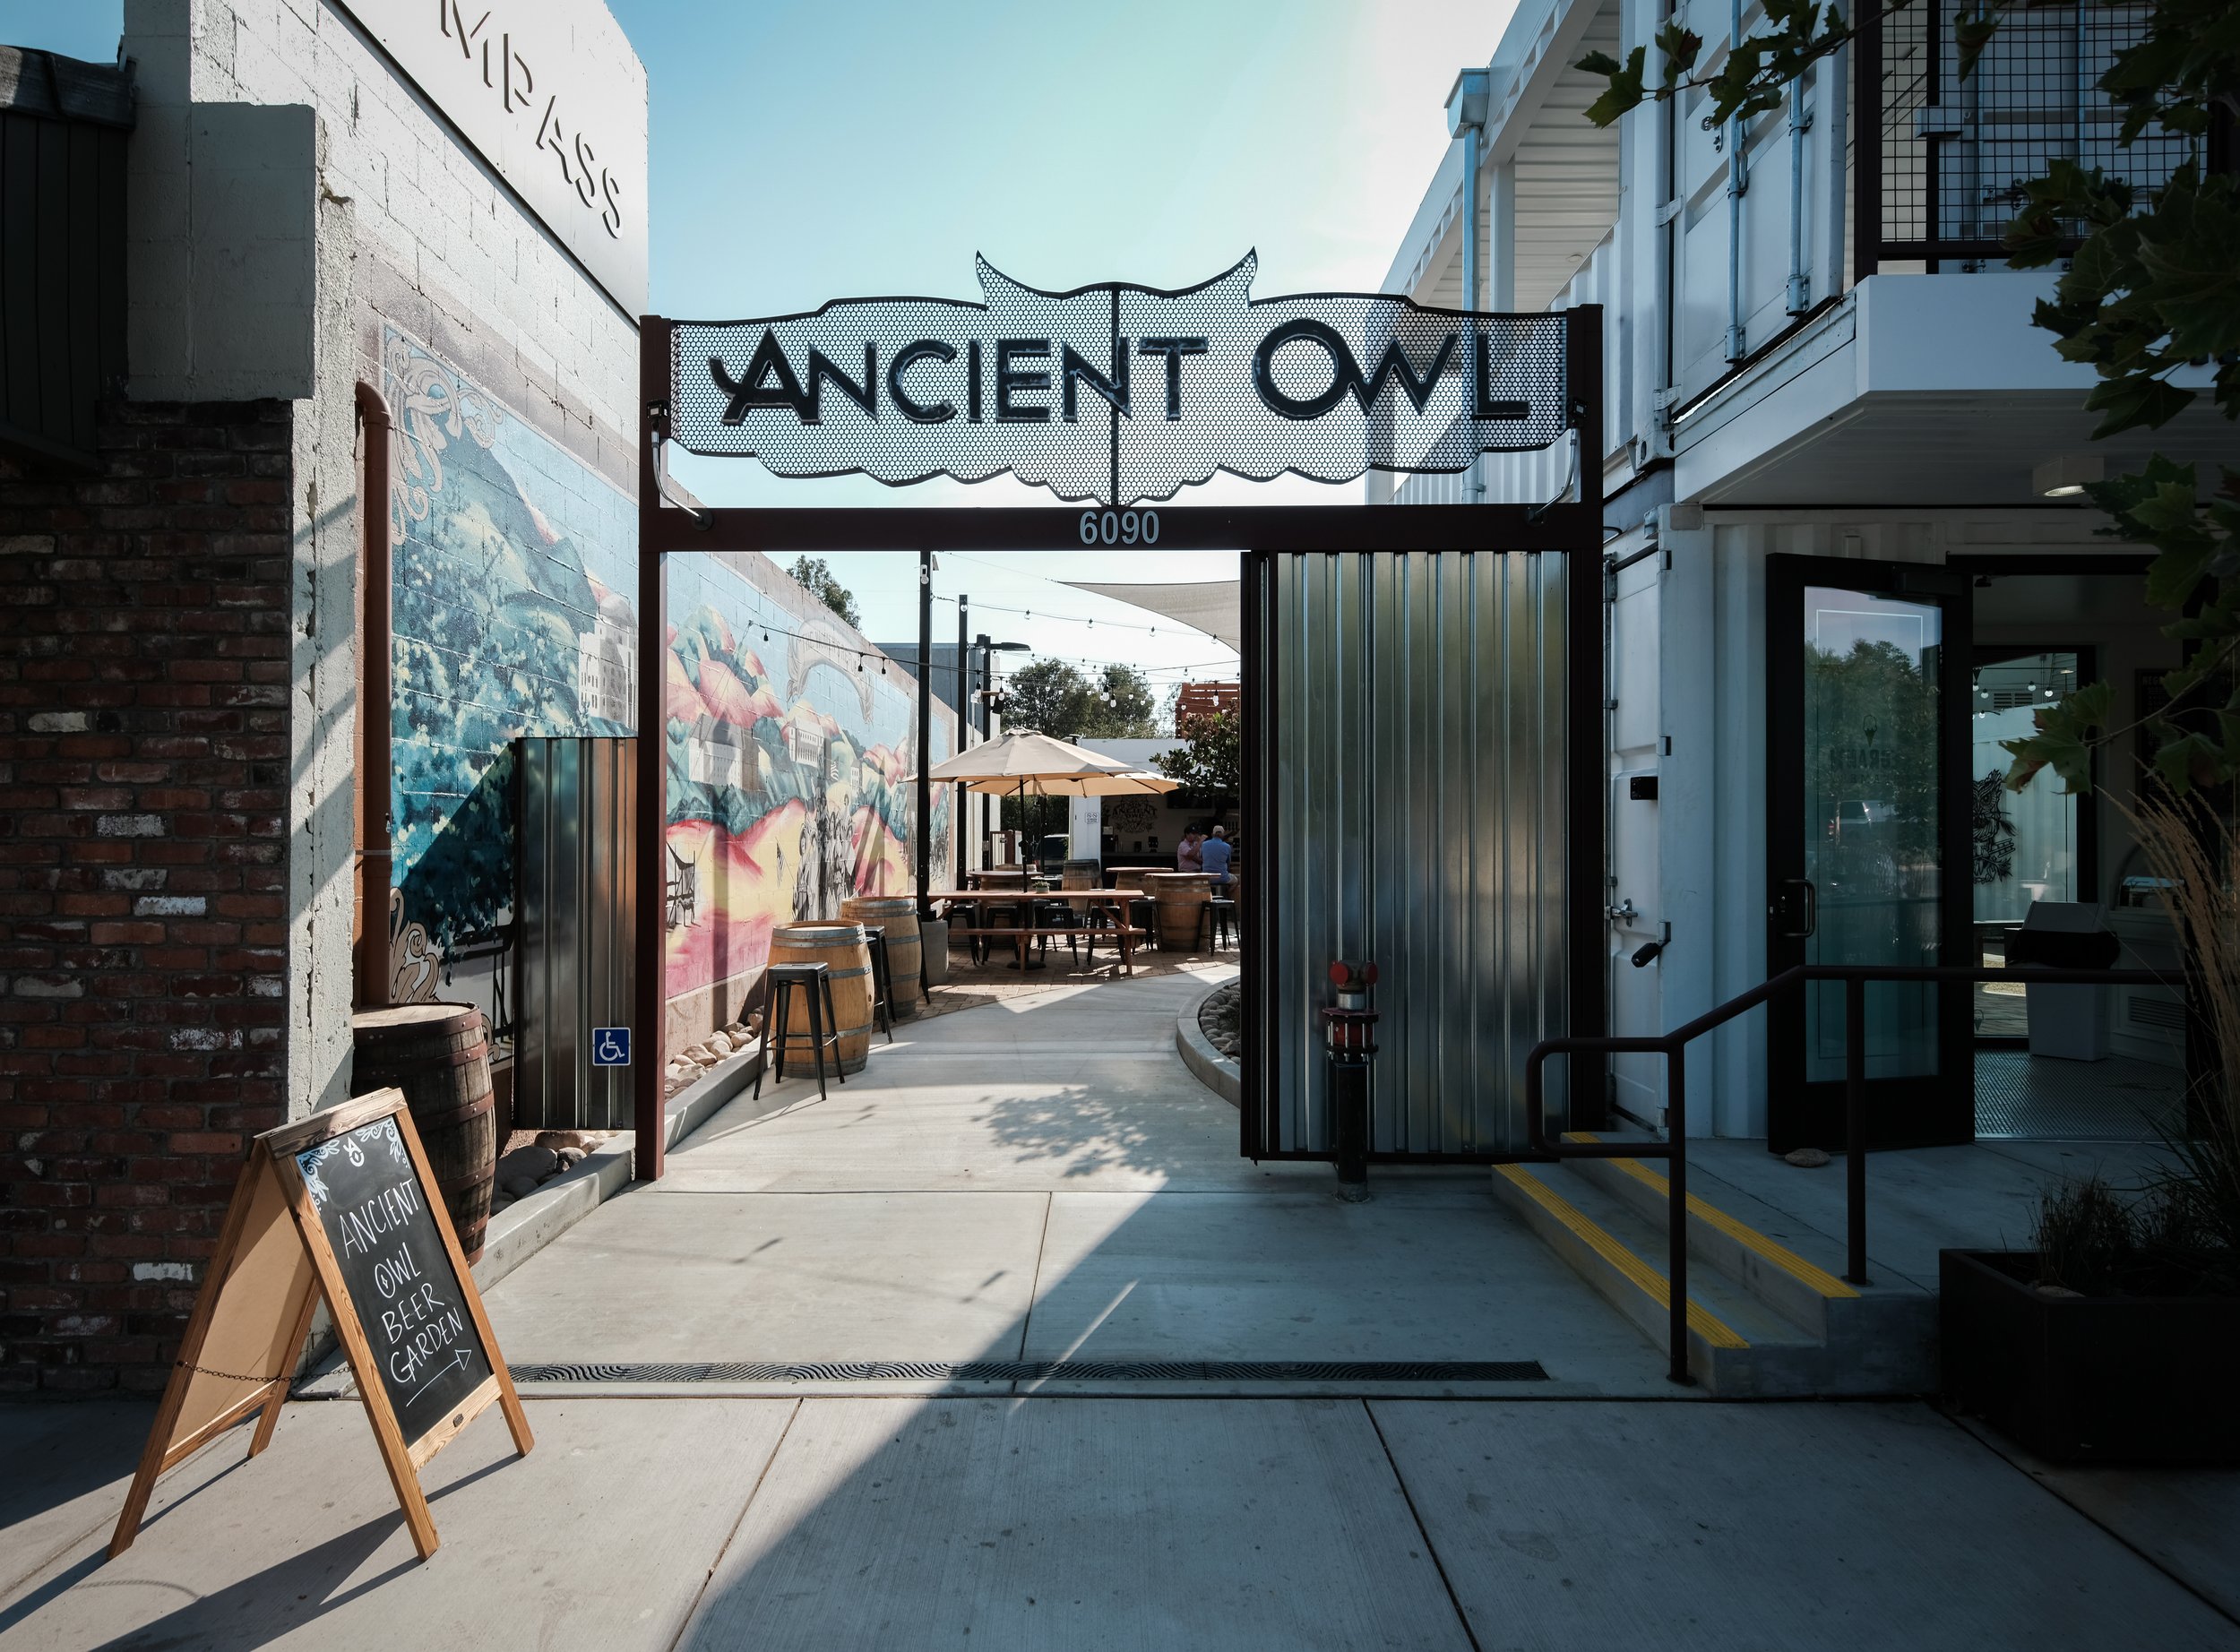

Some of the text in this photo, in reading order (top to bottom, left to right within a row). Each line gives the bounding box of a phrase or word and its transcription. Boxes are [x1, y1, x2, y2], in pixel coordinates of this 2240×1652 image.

[708, 318, 1531, 426] ANCIENT OWL
[1079, 510, 1160, 545] 6090
[1112, 806, 1158, 816] ANCIENT
[339, 1178, 419, 1259] ANCIENT
[374, 1242, 422, 1299] OWL
[381, 1282, 445, 1344] BEER
[390, 1307, 464, 1383] GARDEN
